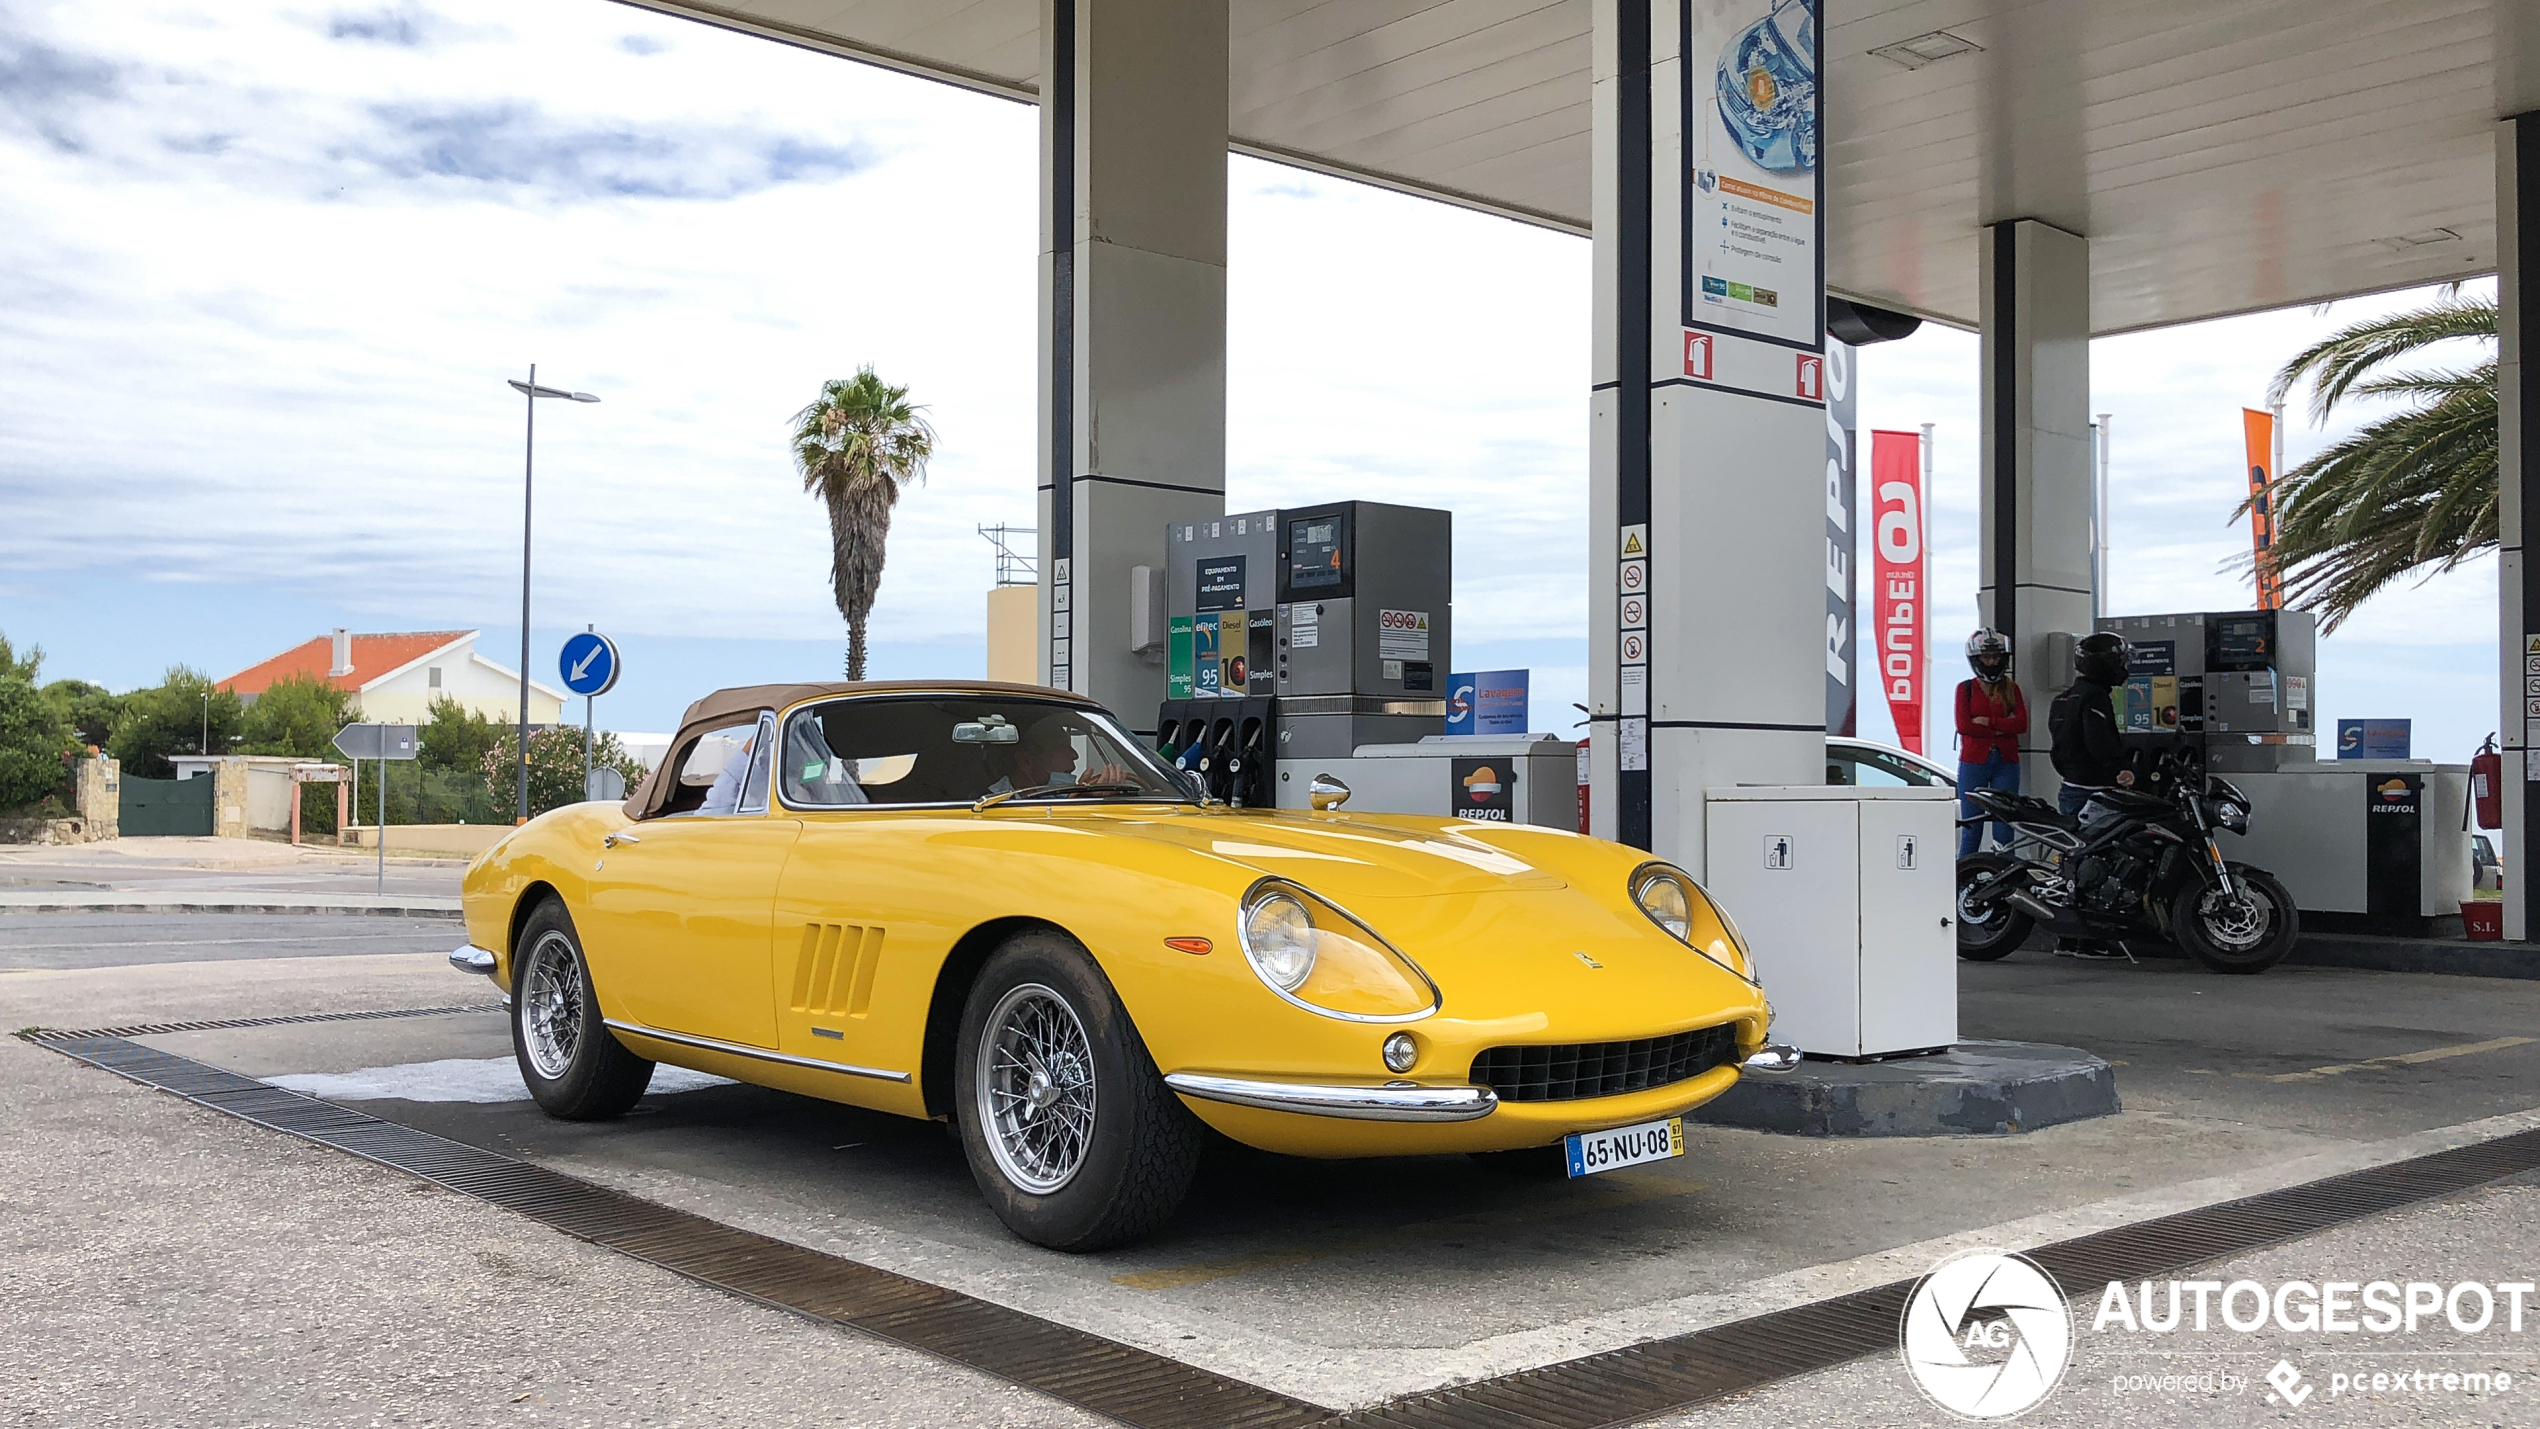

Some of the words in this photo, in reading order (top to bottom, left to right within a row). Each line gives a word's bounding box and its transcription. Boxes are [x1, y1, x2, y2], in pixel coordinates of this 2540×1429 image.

[1330, 549, 1341, 569] 4
[1205, 565, 1237, 575] EQUIPAMENTO
[1201, 583, 1240, 593] PRÉ-PAGAMENTO
[1195, 621, 1218, 631] efitec
[1222, 620, 1242, 630] Diesel
[1249, 618, 1273, 628] Gasóleo
[1170, 625, 1192, 634] Gasolina
[2255, 637, 2266, 654] 2
[1170, 674, 1192, 685] Simples
[1202, 668, 1218, 686] 95
[1249, 669, 1274, 681] Simples
[1183, 685, 1192, 694] 95
[2179, 680, 2203, 688] Gasóleo
[1478, 687, 1524, 700] Lavagem
[2134, 713, 2150, 725] 95
[2180, 714, 2203, 723] Simples
[1458, 808, 1507, 821] REPSOL
[2372, 804, 2416, 814] REPSOL
[2472, 921, 2496, 933] S.I.
[1672, 1124, 1681, 1135] 67
[1673, 1139, 1682, 1150] 01
[1574, 1162, 1581, 1173] P
